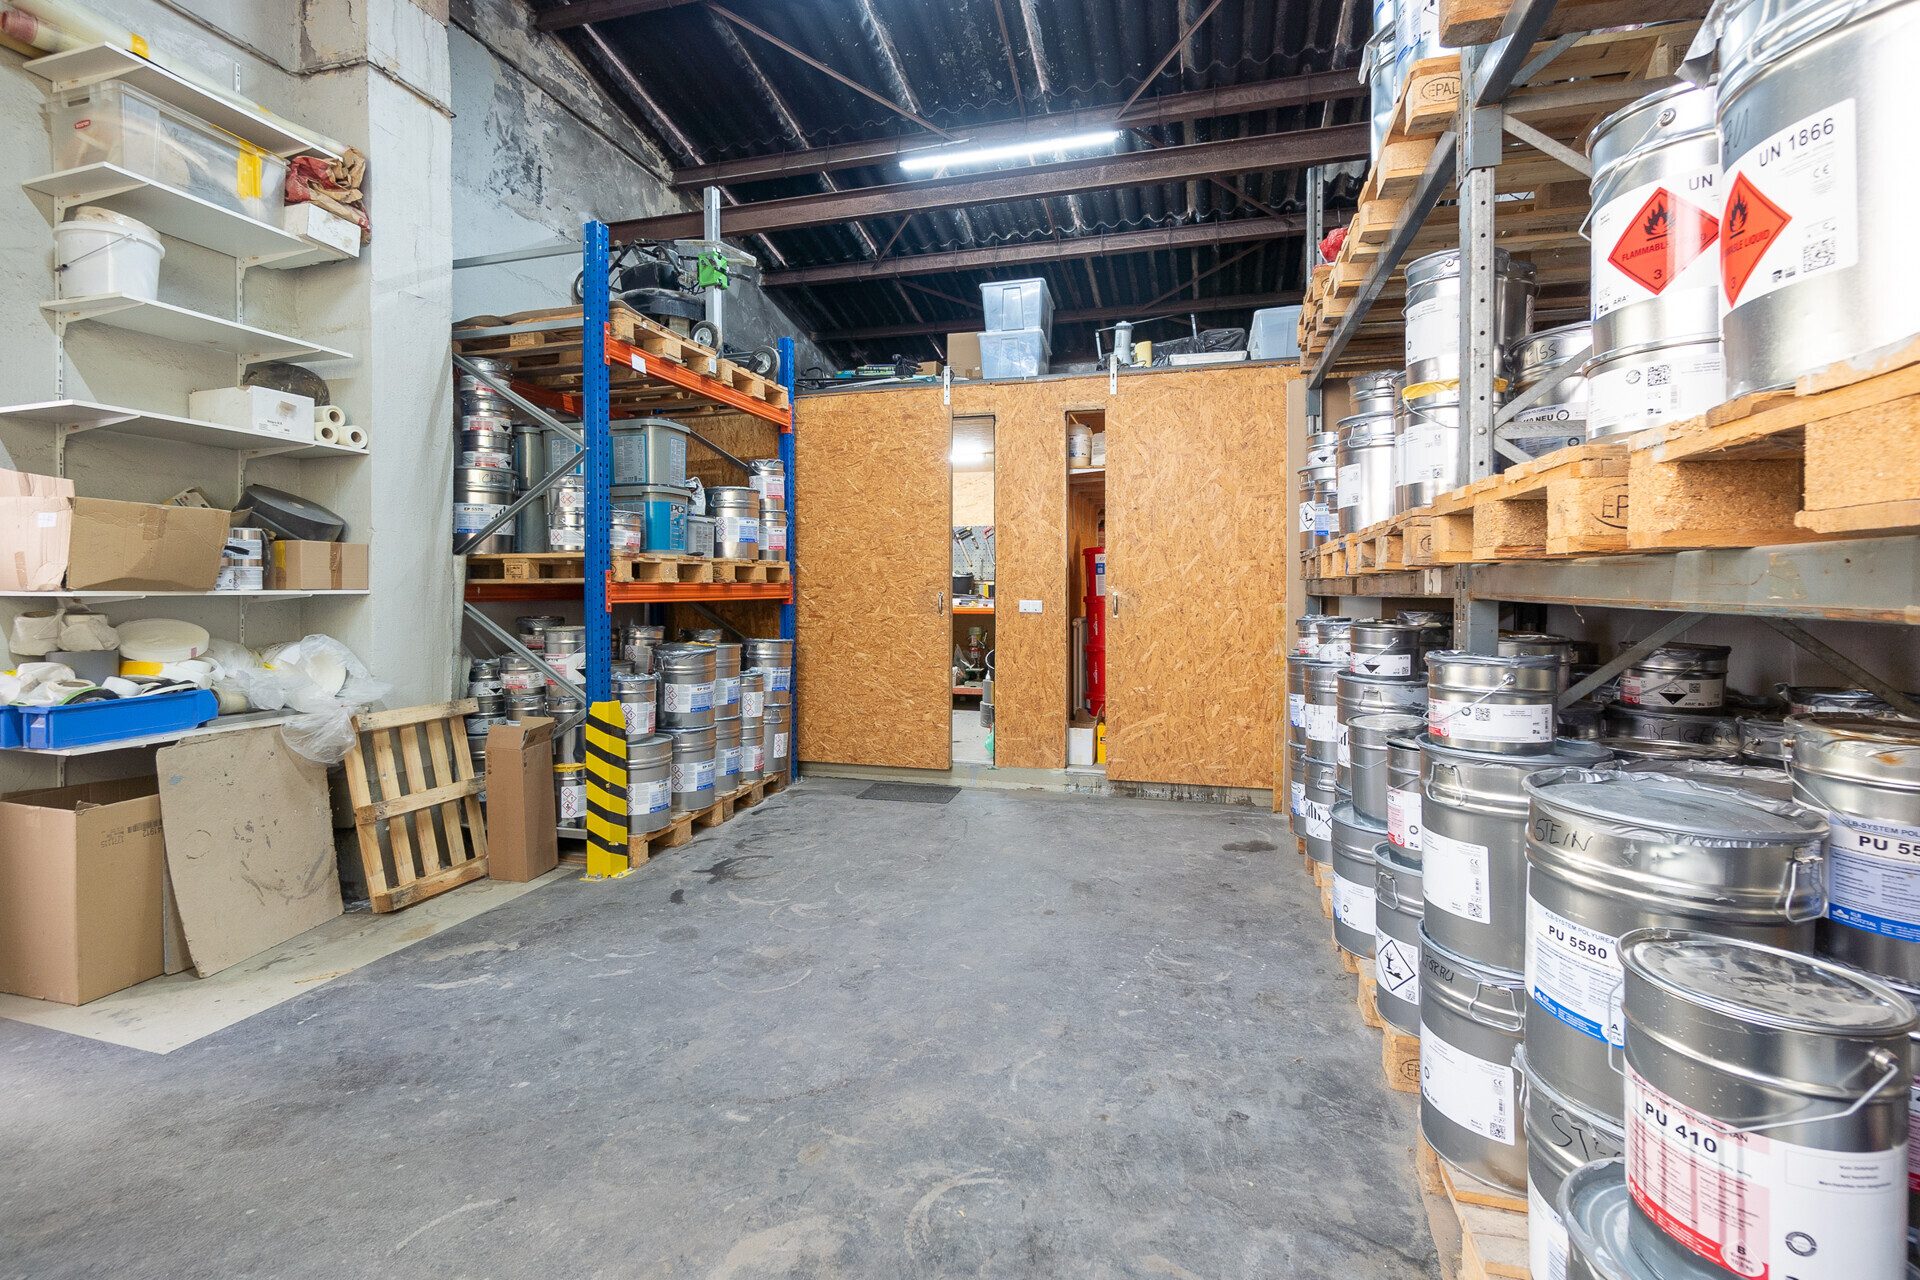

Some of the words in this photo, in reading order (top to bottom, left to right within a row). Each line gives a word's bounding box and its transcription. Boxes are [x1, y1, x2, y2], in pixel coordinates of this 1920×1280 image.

[1428, 80, 1460, 98] EPAL
[1760, 141, 1781, 168] UN
[1788, 117, 1834, 151] 1866
[1689, 174, 1713, 191] UN
[1653, 269, 1663, 280] 3
[1730, 276, 1737, 290] 3
[1535, 413, 1554, 422] NEU
[1535, 819, 1594, 851] STEIN
[1858, 835, 1889, 852] PU
[1548, 924, 1565, 942] PU
[1569, 936, 1608, 960] 5580
[1645, 1102, 1667, 1127] PU
[1675, 1124, 1718, 1154] 410
[1736, 1244, 1748, 1256] B
